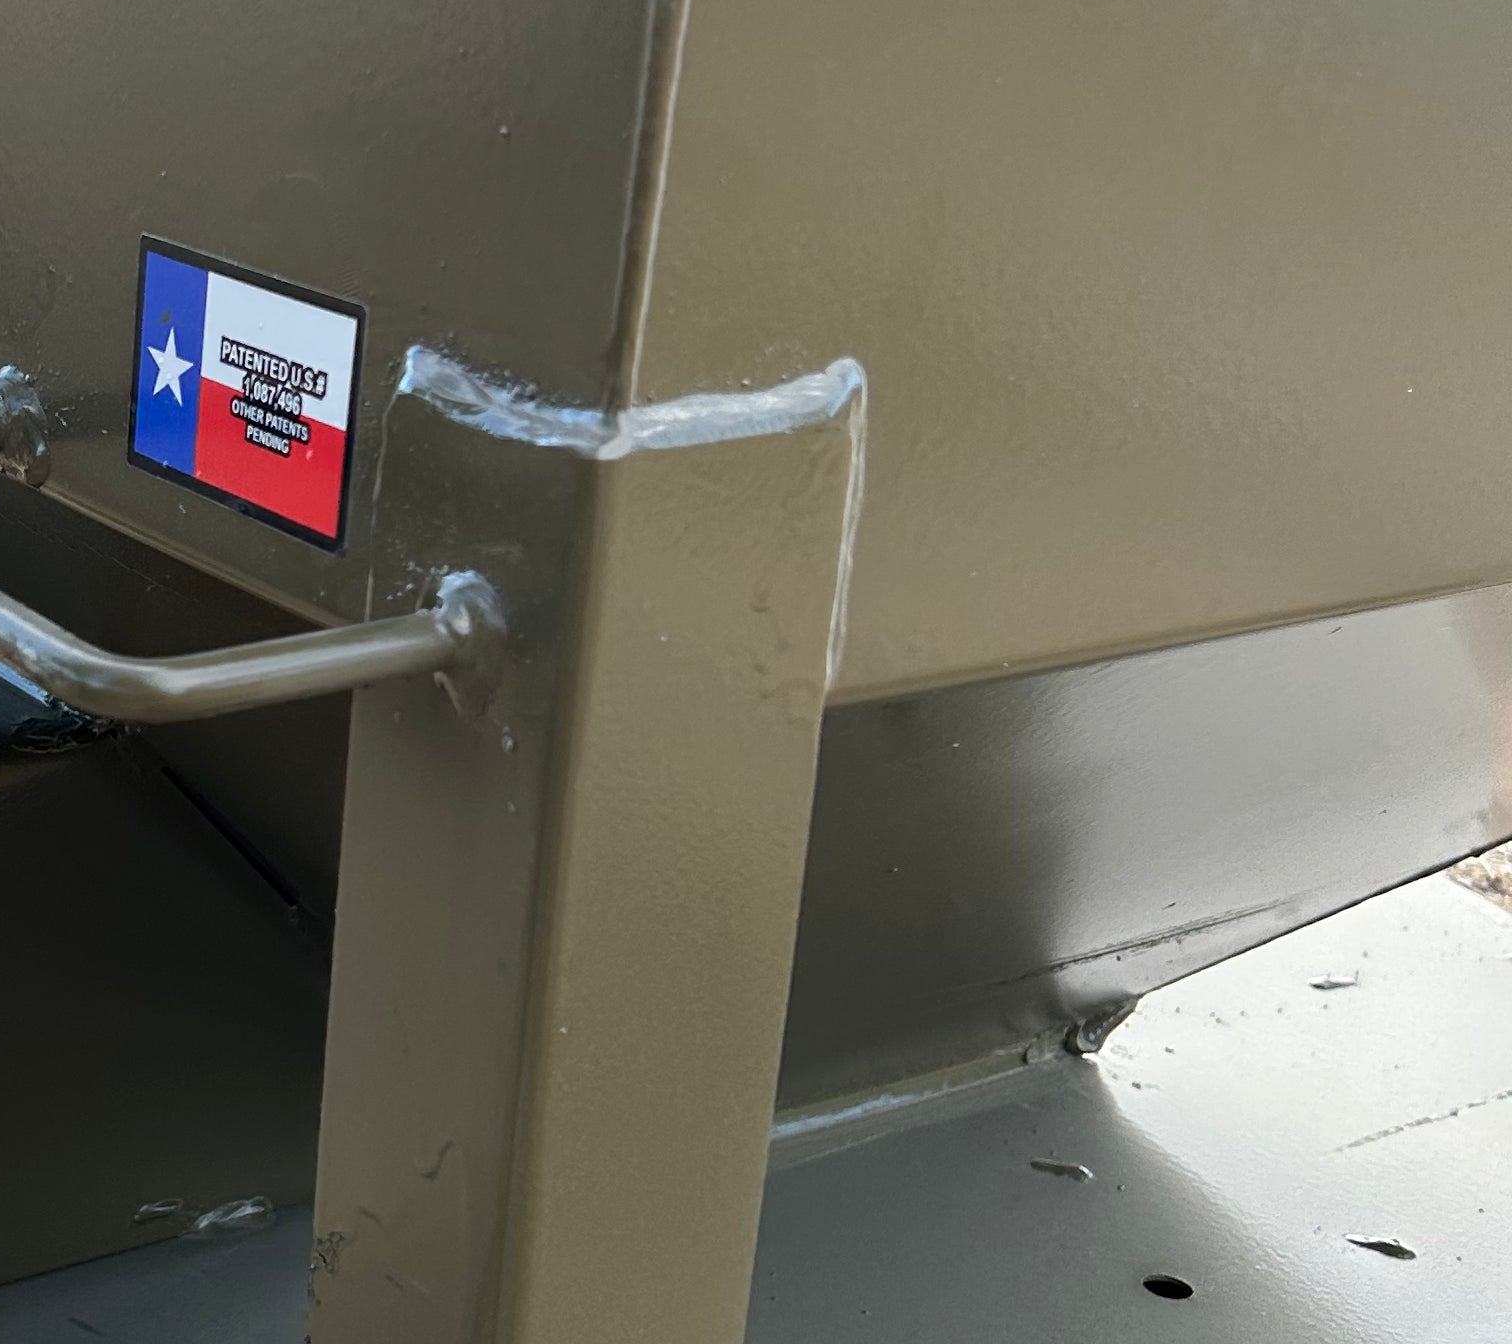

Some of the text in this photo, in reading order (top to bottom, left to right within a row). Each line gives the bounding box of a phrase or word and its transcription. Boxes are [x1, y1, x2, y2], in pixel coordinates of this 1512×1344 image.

[221, 339, 289, 383] PATENTED
[231, 398, 309, 442] OTHER PATENTS
[246, 424, 290, 454] PENDING
